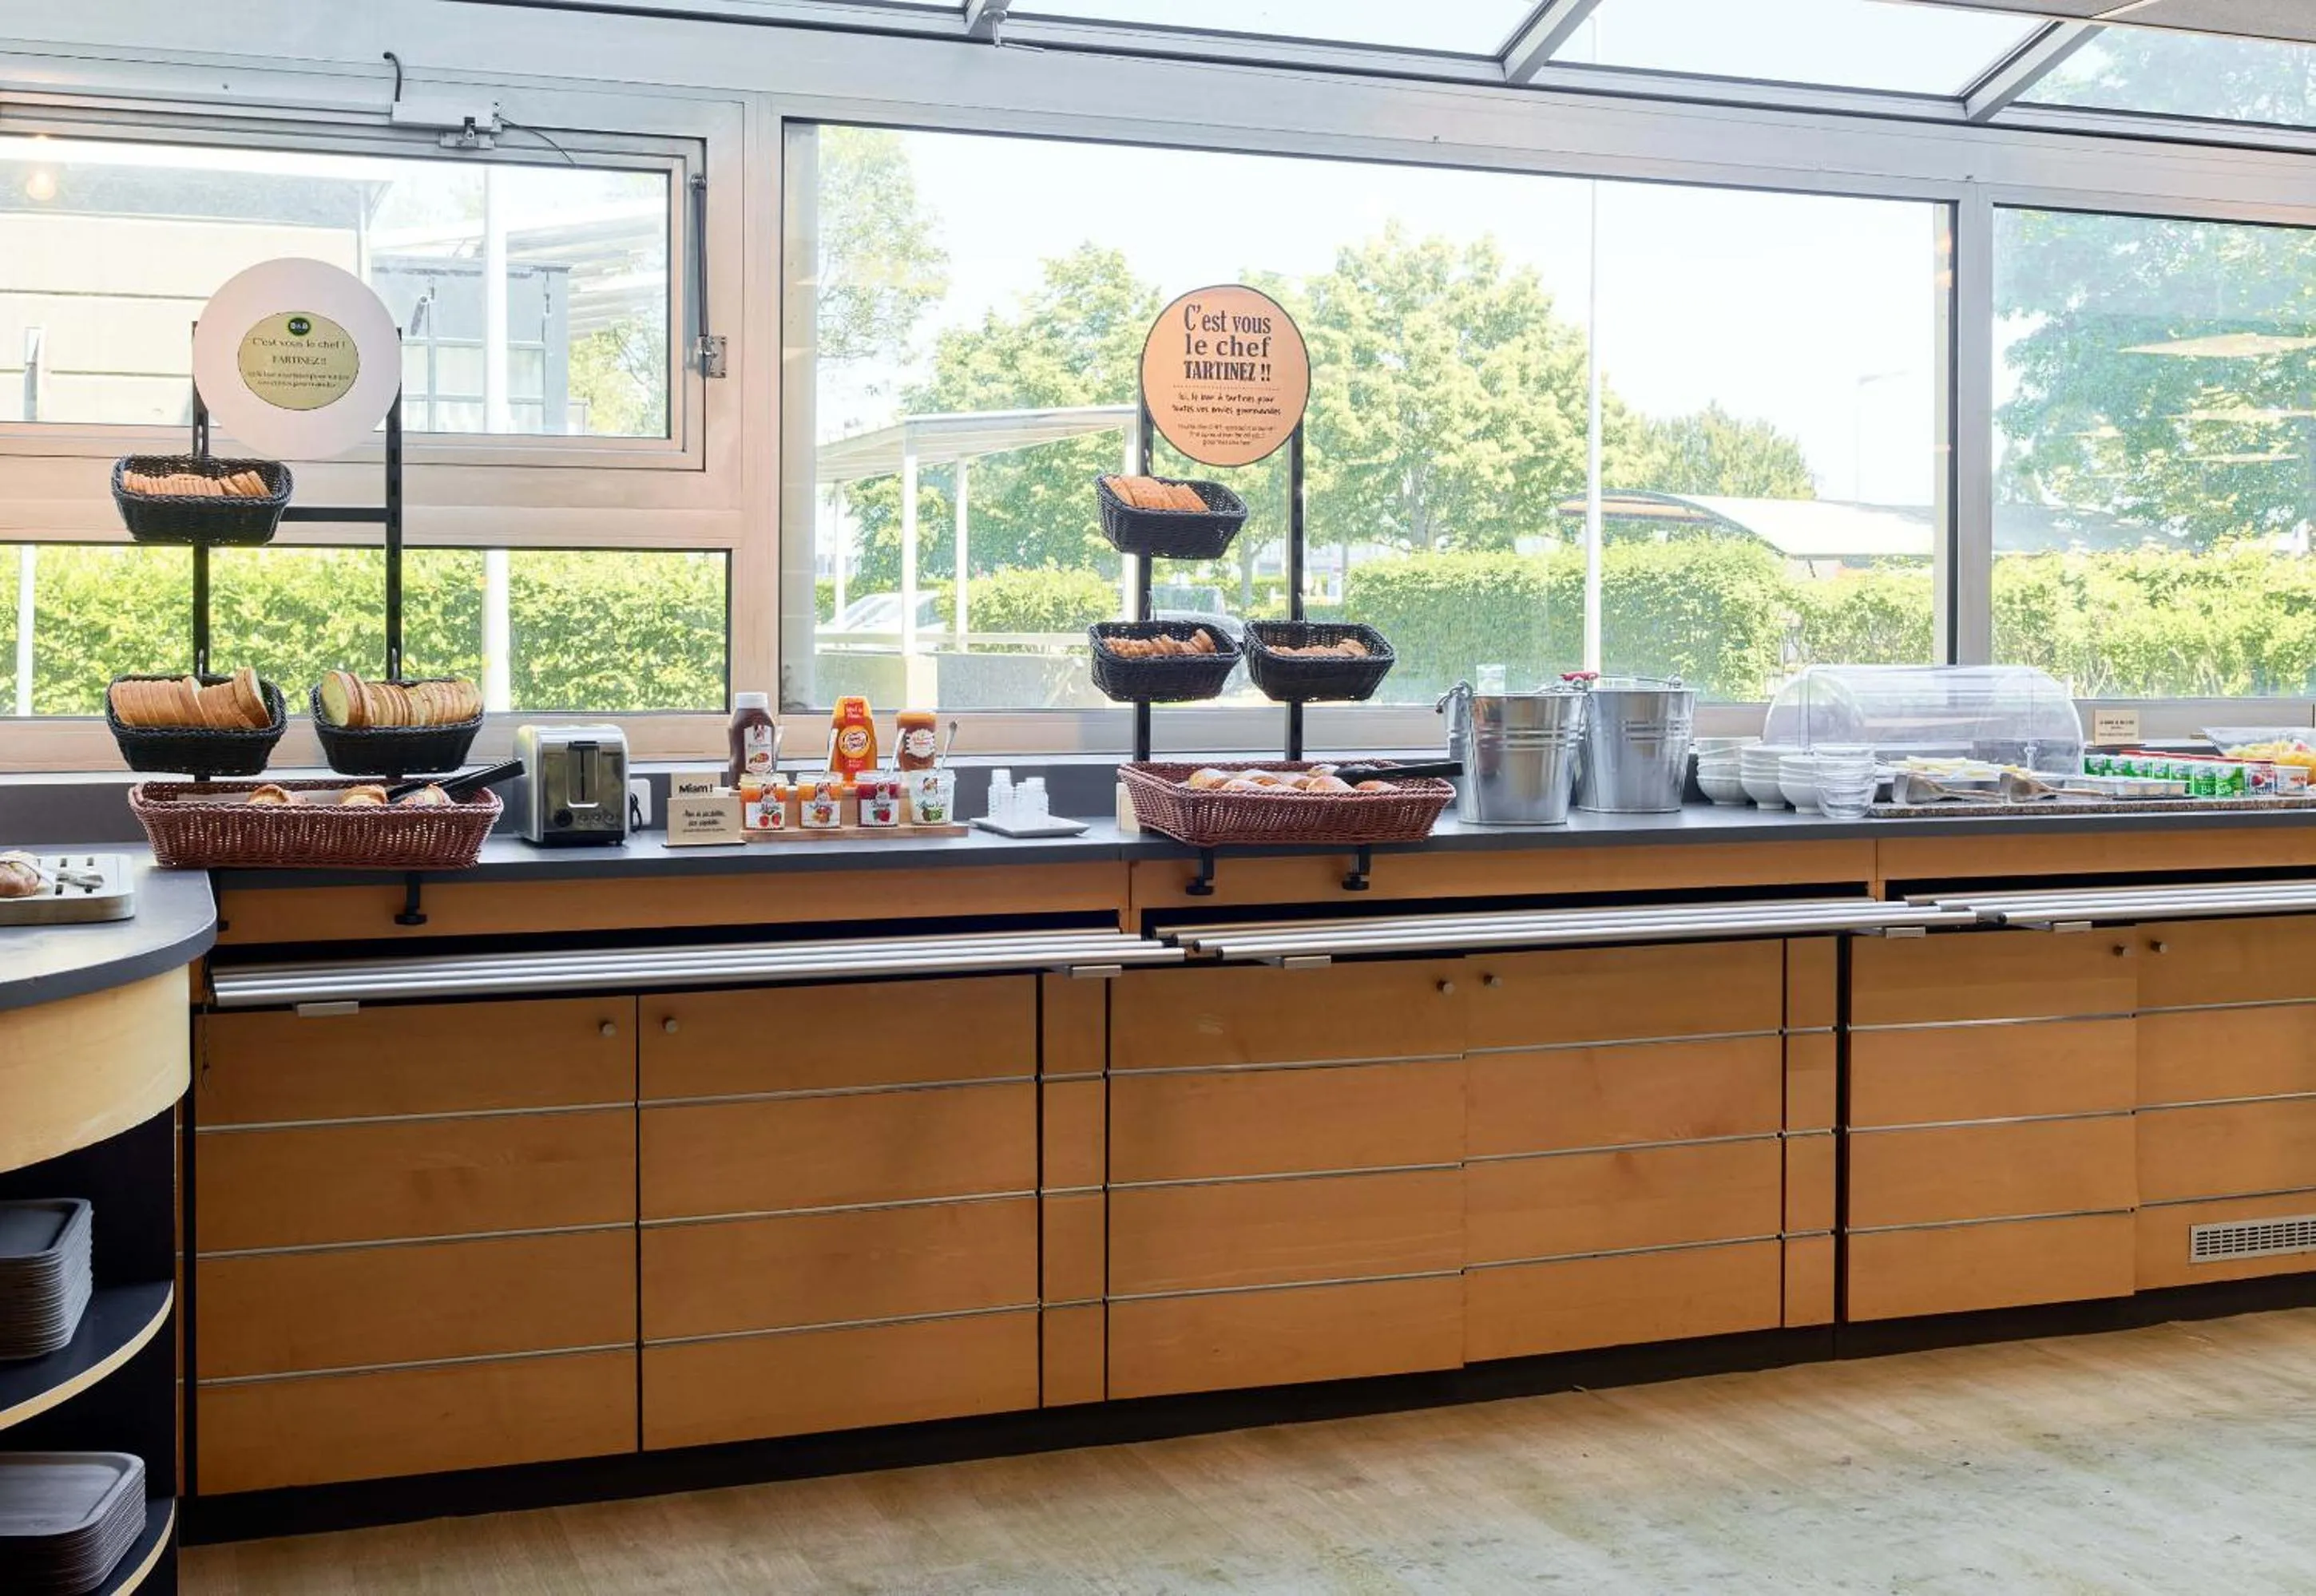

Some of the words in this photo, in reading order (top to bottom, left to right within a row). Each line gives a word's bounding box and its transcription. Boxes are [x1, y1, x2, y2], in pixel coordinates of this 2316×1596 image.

[1184, 303, 1227, 333] C'est
[1232, 315, 1271, 334] vous
[252, 338, 276, 347] C'est
[318, 340, 339, 349] chef
[1185, 334, 1208, 356] le
[1216, 335, 1271, 358] chef
[1184, 361, 1256, 382] TARTINEZ
[1261, 364, 1271, 382] !!
[679, 783, 708, 793] Miam
